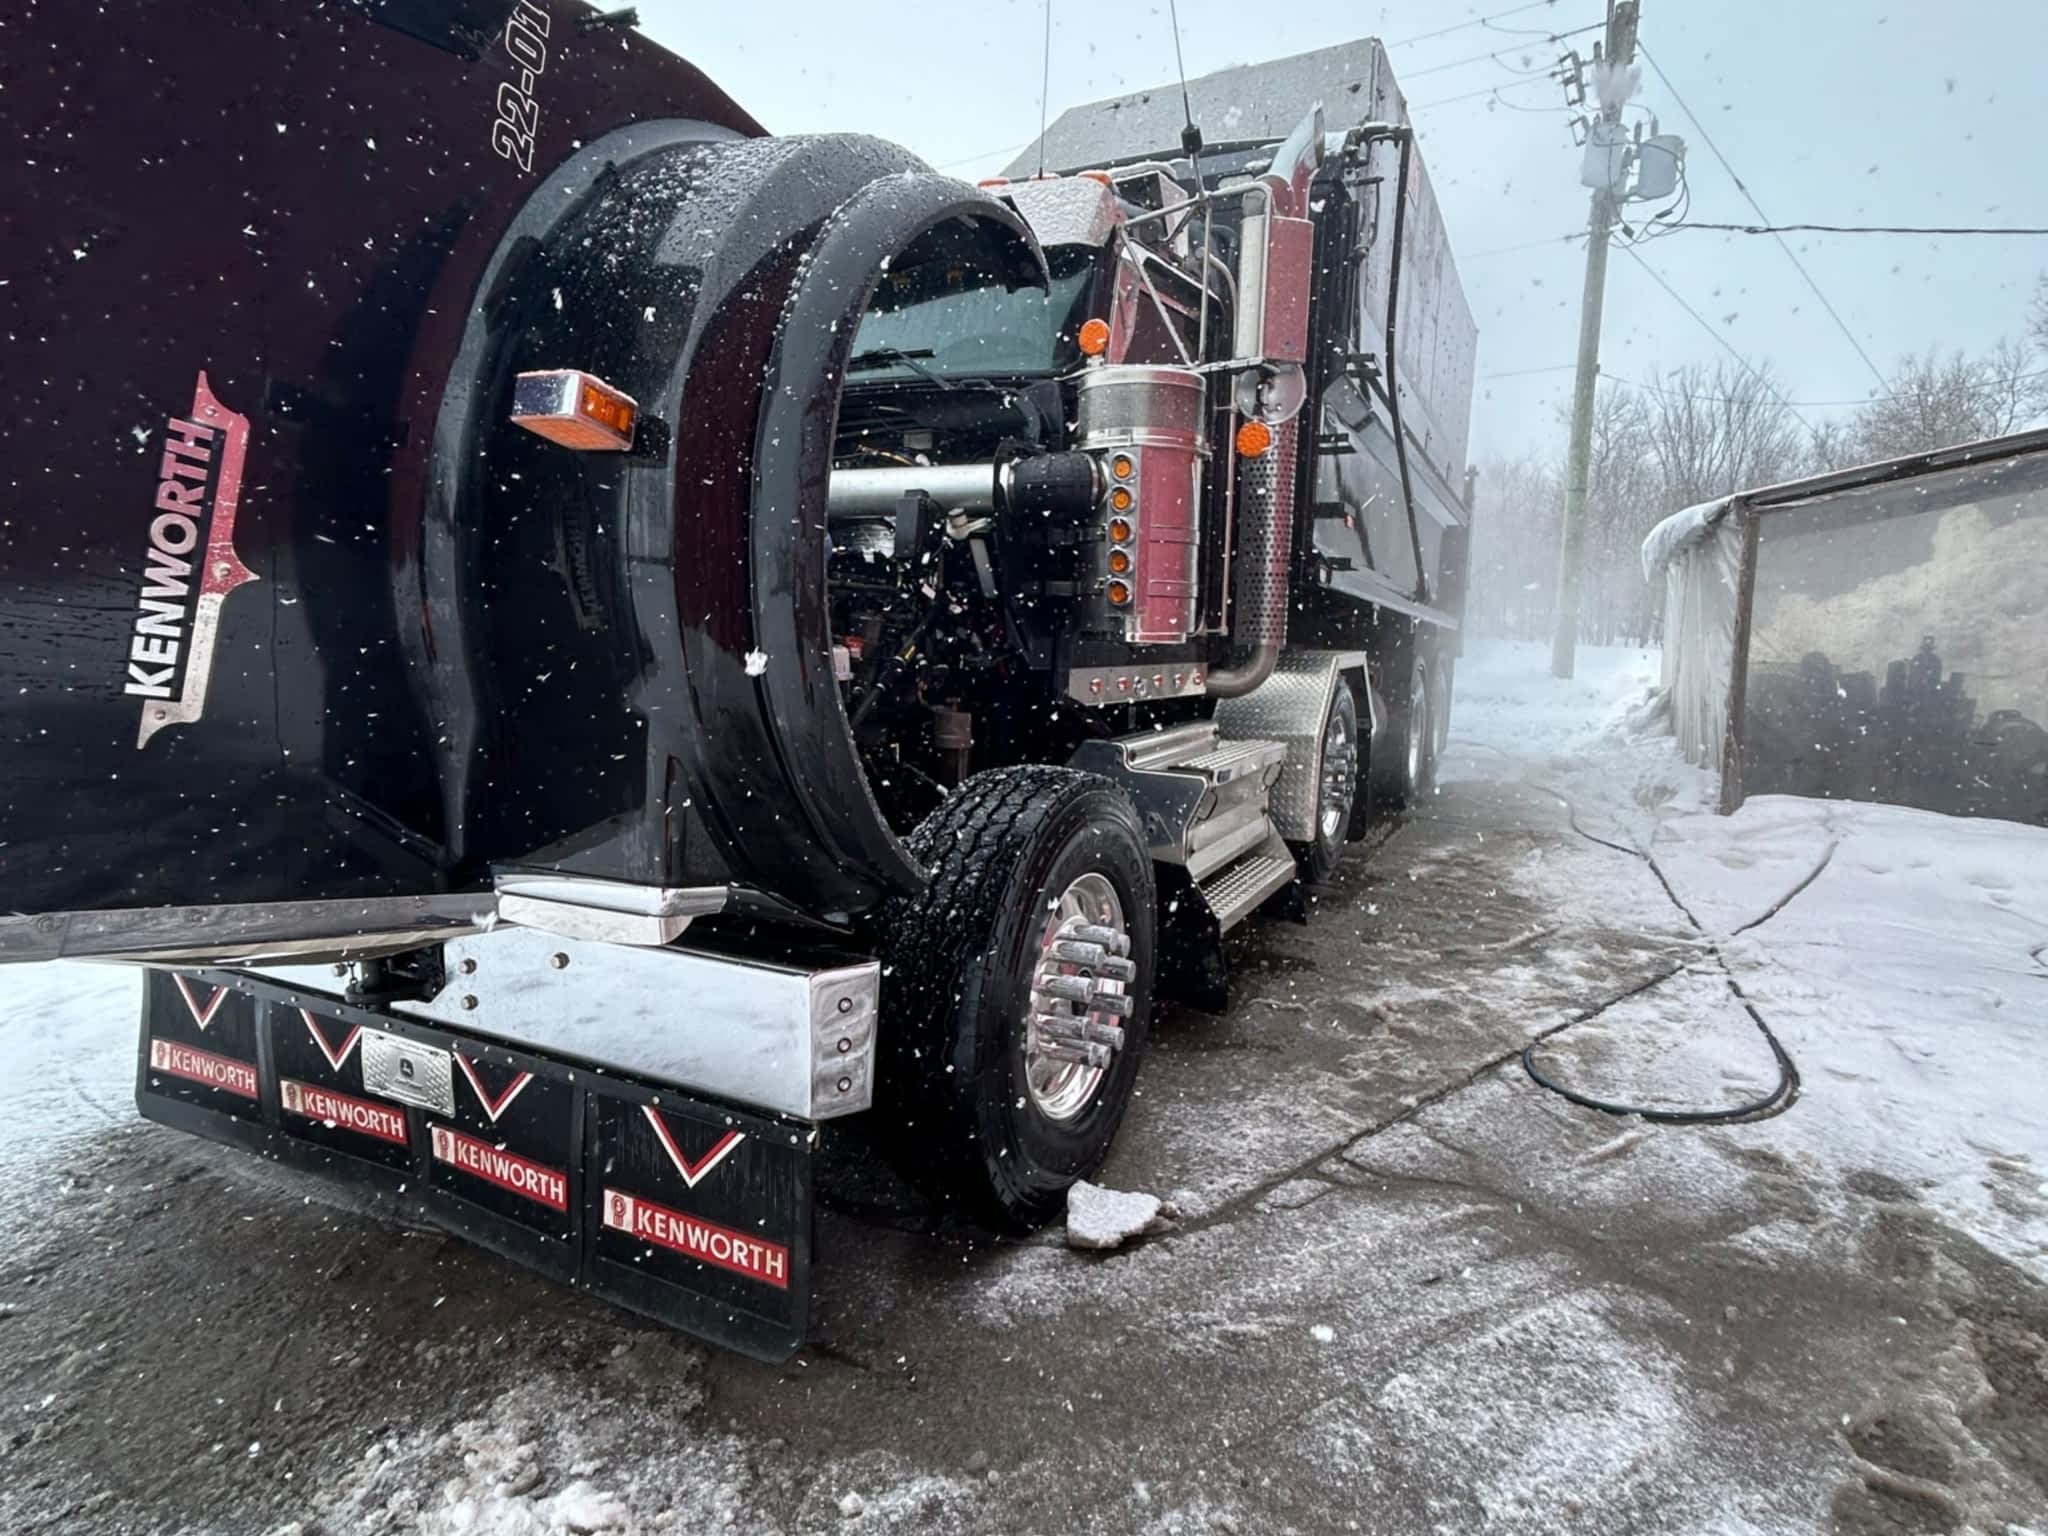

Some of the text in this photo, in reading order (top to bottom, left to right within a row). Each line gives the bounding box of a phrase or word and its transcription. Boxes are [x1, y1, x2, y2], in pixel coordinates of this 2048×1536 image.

[492, 0, 550, 172] 22-01
[124, 417, 215, 697] KENWORTH
[172, 1050, 256, 1092] KENWORTH
[304, 1093, 404, 1137] KENWORTH
[457, 1140, 565, 1204] KENWORTH
[637, 1206, 784, 1278] KENWORTH
